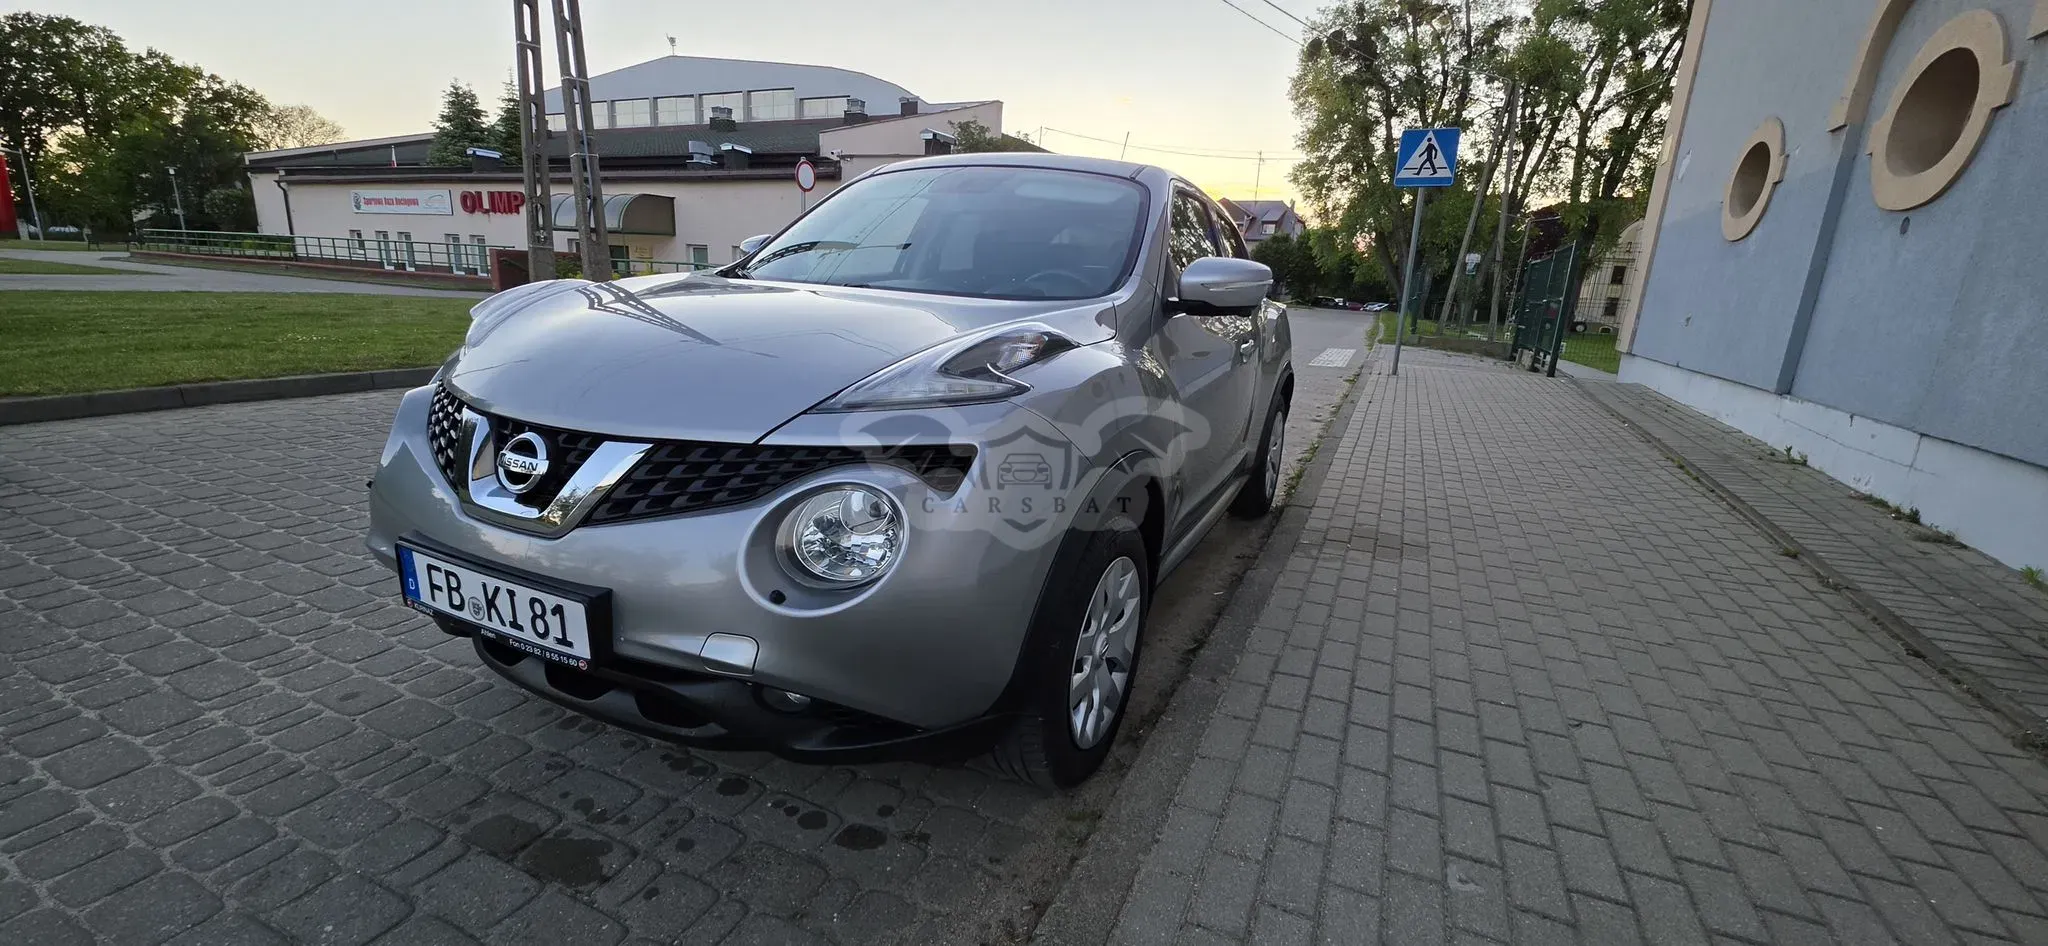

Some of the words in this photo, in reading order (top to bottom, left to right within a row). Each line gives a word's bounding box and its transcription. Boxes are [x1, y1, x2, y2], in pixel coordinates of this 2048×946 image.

[460, 191, 525, 215] OLIMP
[426, 563, 466, 612] FB
[509, 638, 520, 648] Fon
[560, 656, 568, 664] 15
